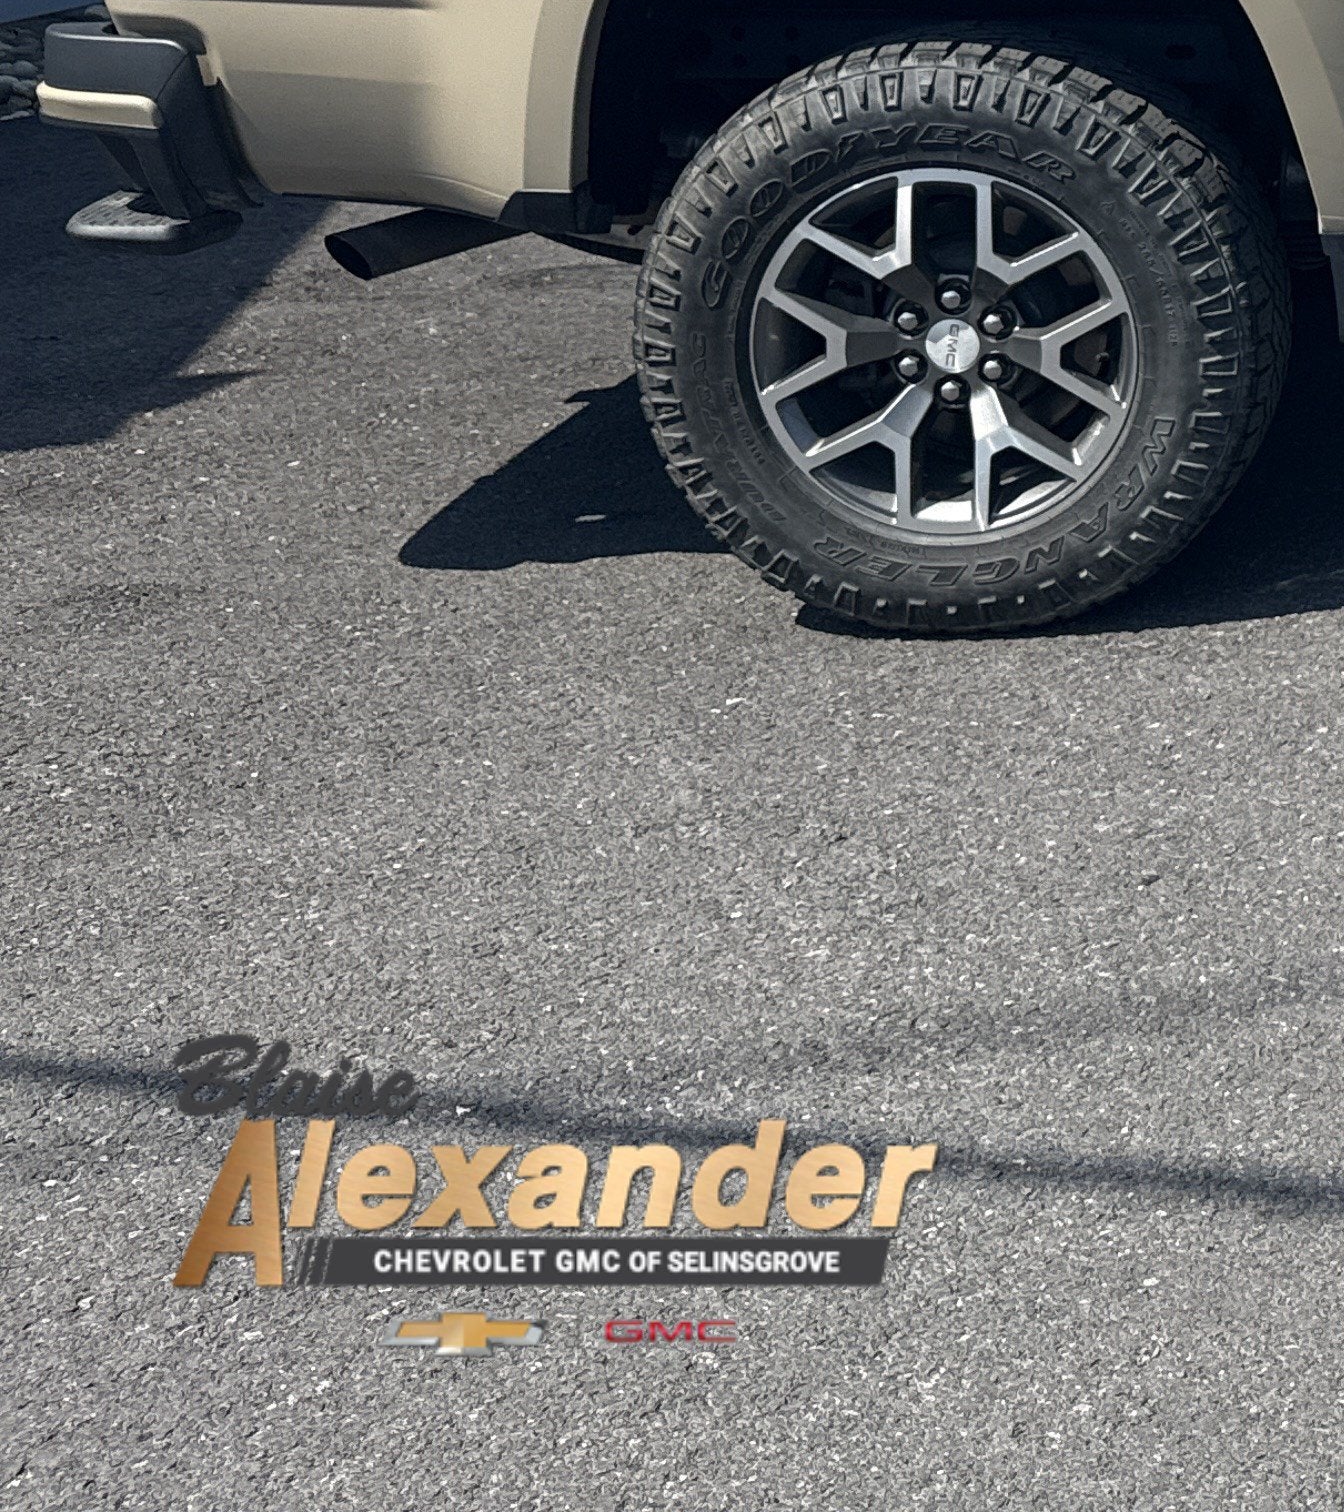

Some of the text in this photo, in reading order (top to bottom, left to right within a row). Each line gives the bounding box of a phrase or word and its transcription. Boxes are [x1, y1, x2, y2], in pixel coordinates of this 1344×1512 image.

[702, 121, 1077, 310] GOODYEAR
[945, 323, 960, 367] GMC
[812, 416, 1176, 587] WRANGLER
